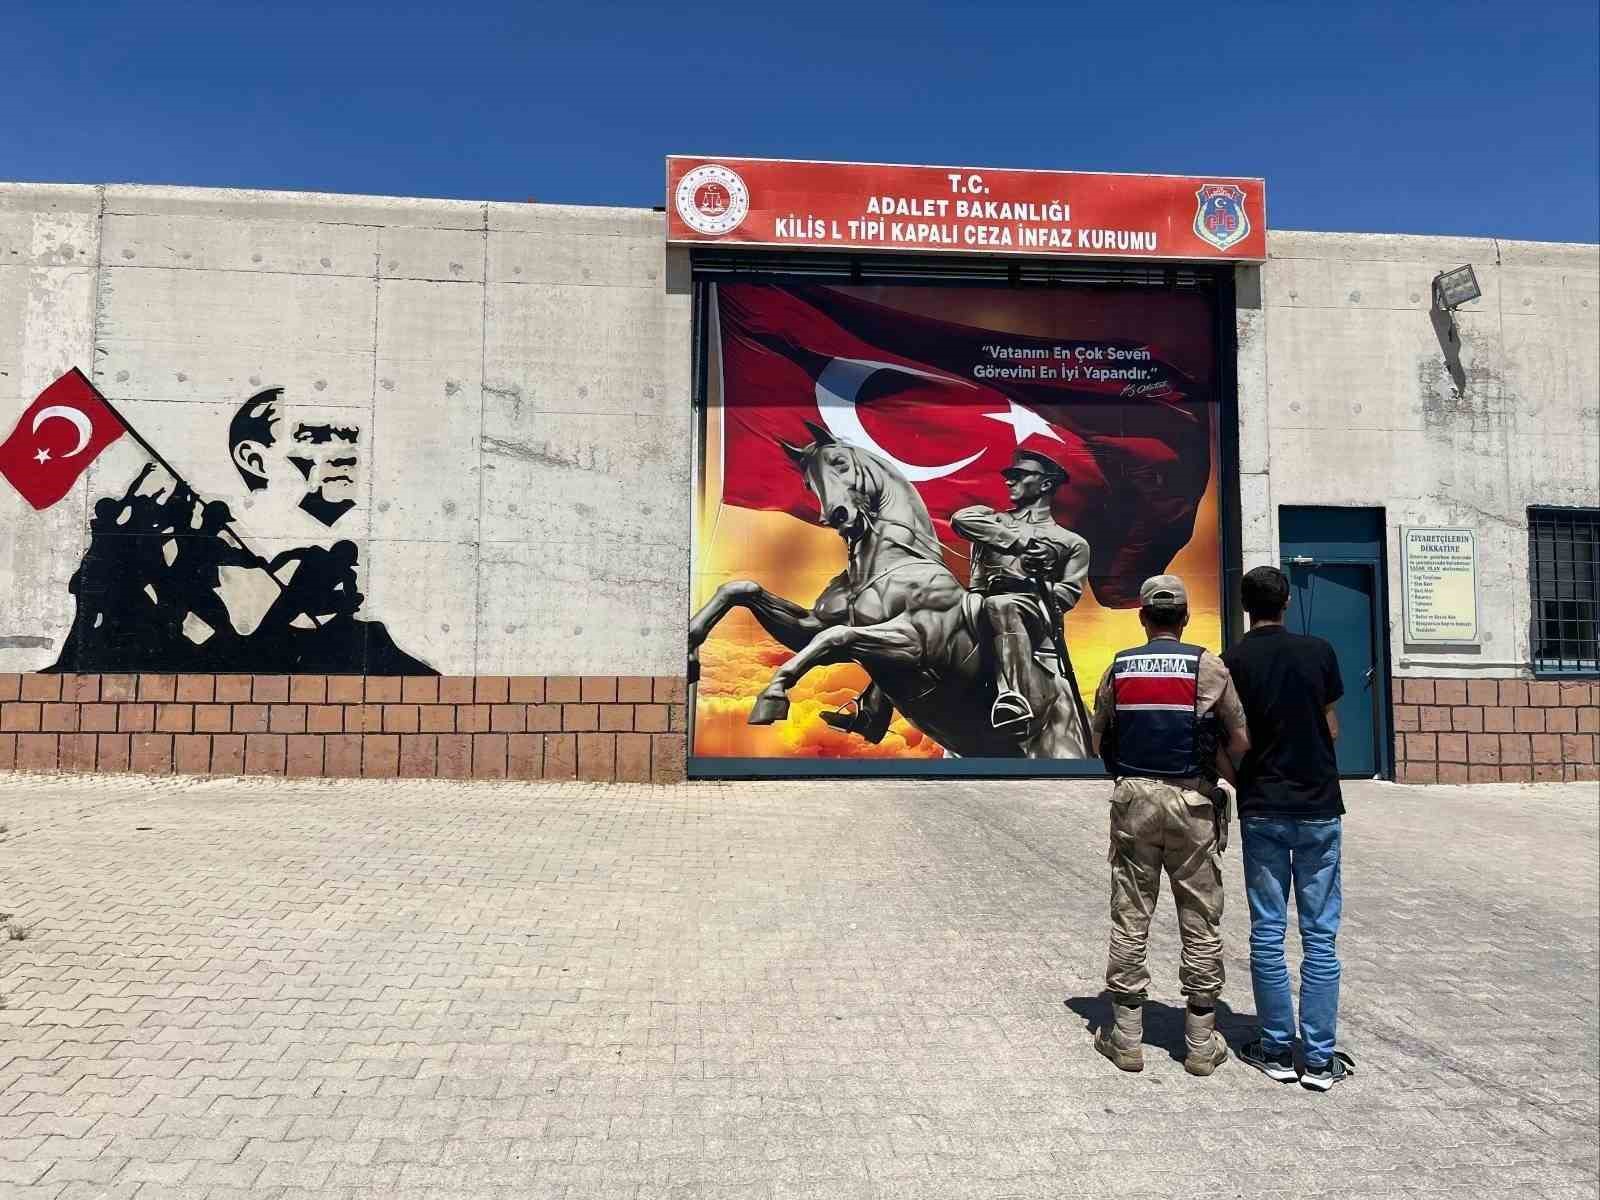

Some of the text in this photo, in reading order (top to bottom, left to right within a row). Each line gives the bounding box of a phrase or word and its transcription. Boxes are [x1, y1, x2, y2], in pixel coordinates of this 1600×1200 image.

[948, 174, 990, 194] T.C.
[866, 196, 1071, 221] ADALET BAKANLIĞI
[775, 214, 1158, 251] KİLİS L TİPİ KAPALI CEZA İNFAZ KURUMU
[1053, 348, 1071, 360] En
[1074, 346, 1103, 363] Çok
[1107, 348, 1151, 361] Seven
[973, 364, 1036, 378] Görevini
[1040, 366, 1057, 378] En
[1061, 363, 1079, 381] İyi
[1122, 658, 1188, 673] JANDARMA
